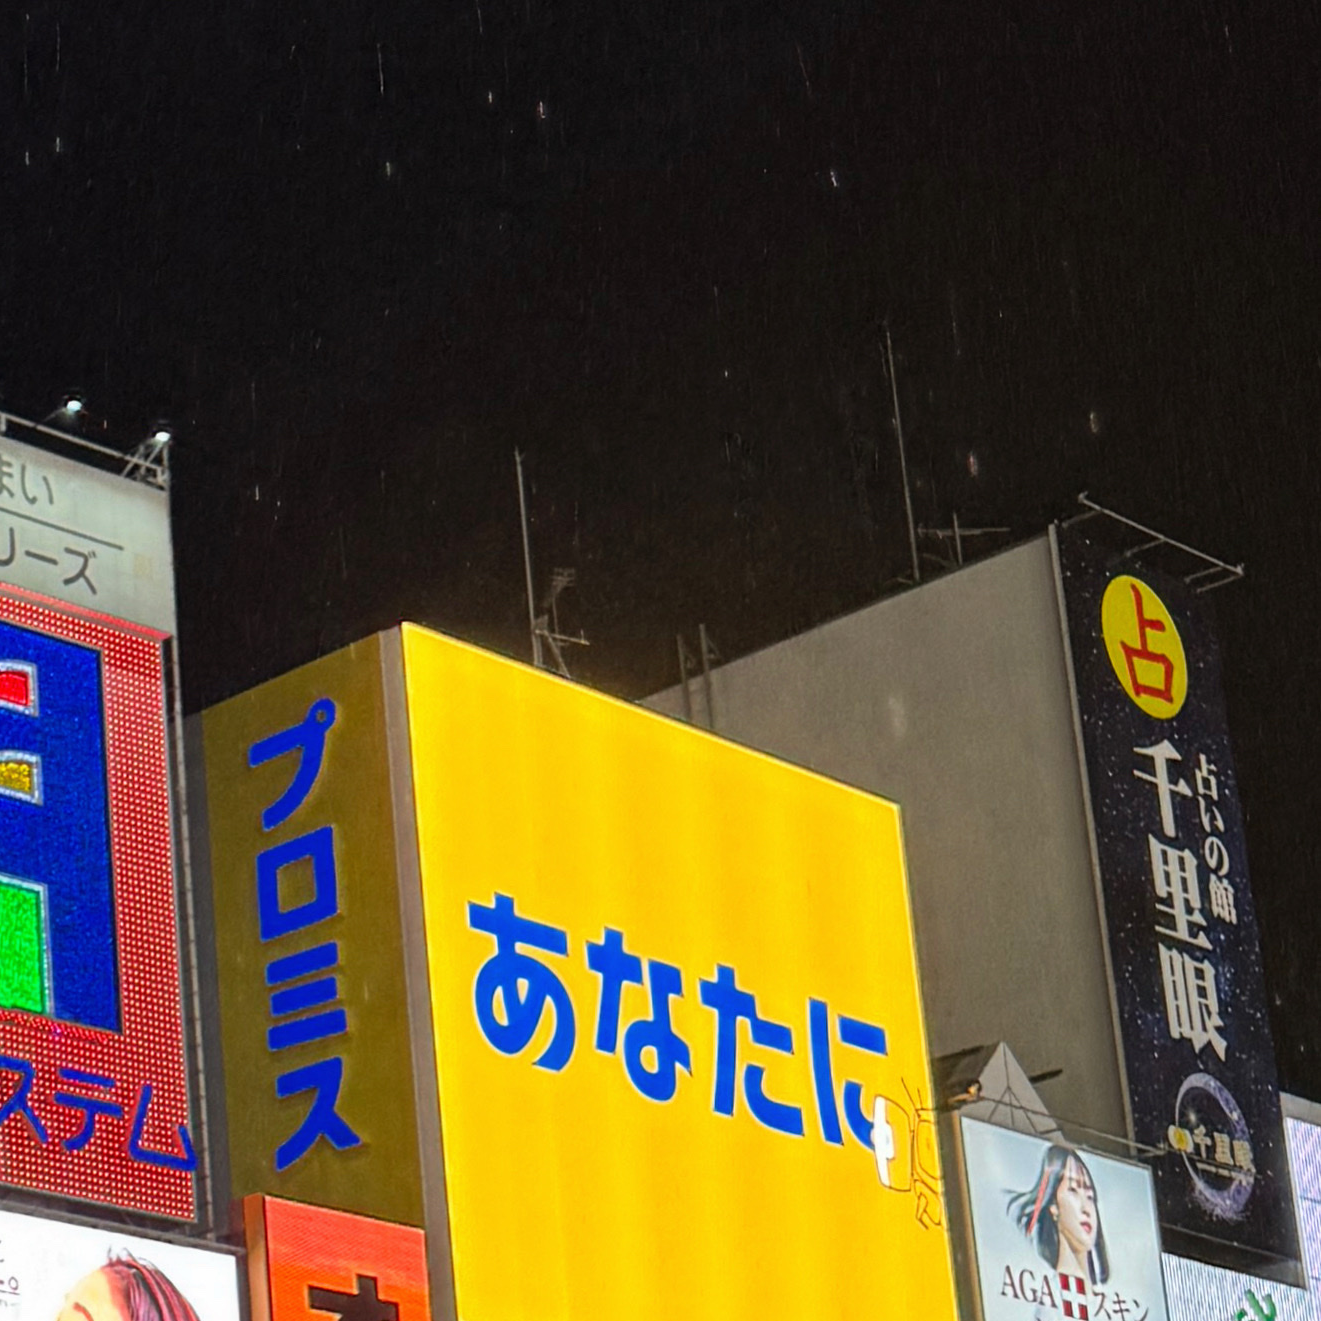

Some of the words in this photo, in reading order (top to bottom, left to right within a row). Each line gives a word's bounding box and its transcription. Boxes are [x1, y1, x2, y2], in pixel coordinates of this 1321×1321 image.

[1121, 582, 1175, 704] 占
[248, 697, 362, 1174] プロミス
[1133, 739, 1228, 1063] 千里眼
[1194, 753, 1237, 927] 占いの館
[467, 890, 888, 1152] あなたに
[1001, 1265, 1058, 1309] AGA
